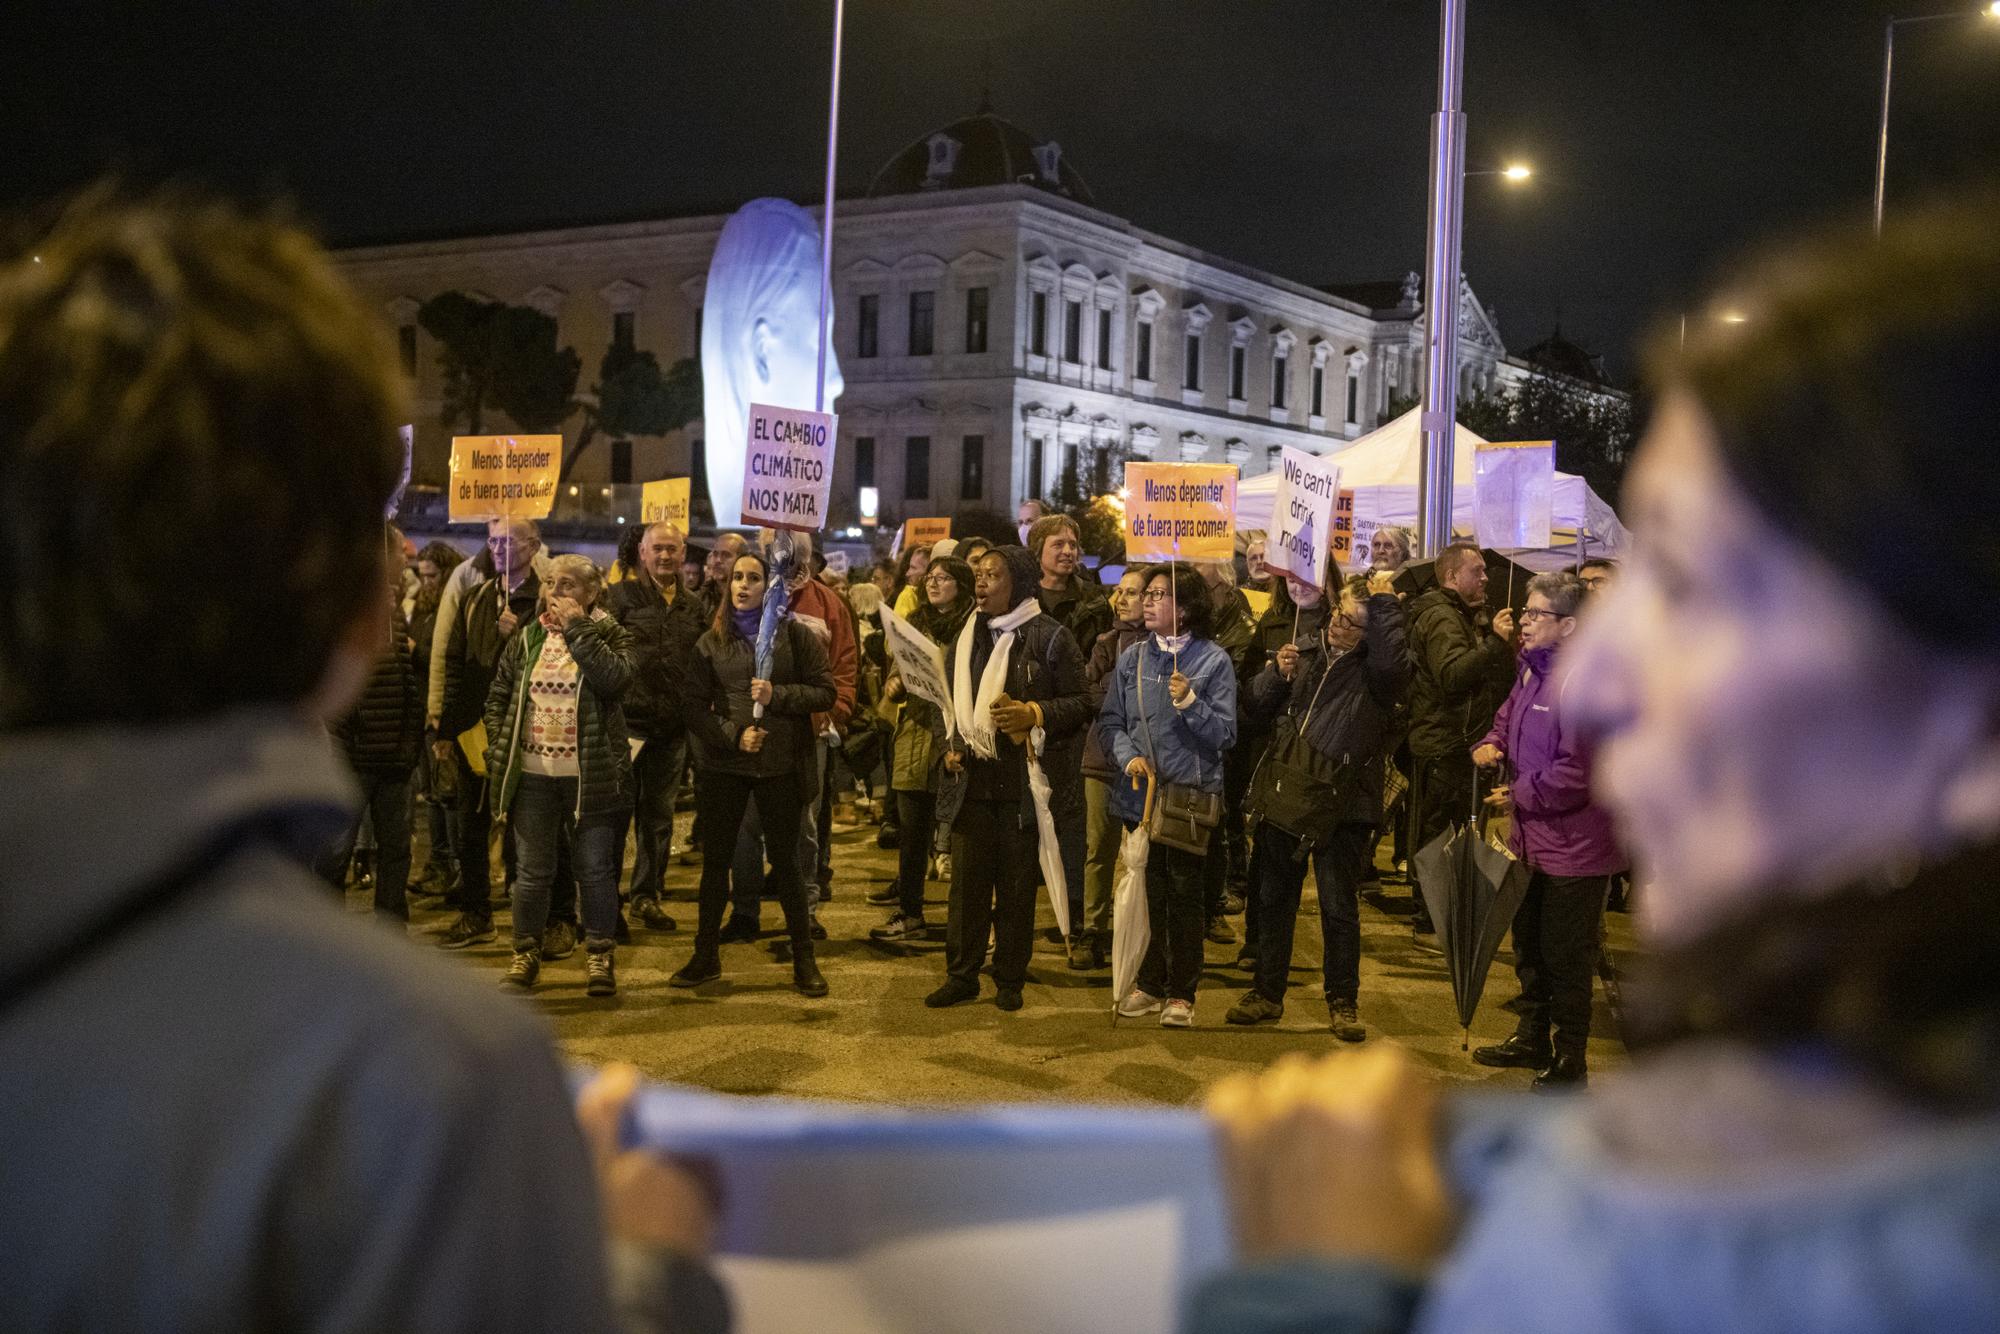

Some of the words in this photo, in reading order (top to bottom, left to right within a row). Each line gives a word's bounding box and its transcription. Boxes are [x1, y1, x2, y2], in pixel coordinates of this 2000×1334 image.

[754, 418, 770, 441] EL
[774, 420, 827, 447] CAMBIO
[472, 449, 503, 470] Menos
[506, 448, 550, 473] depender
[752, 450, 823, 482] CLIMÁTICO
[460, 481, 471, 500] de
[473, 480, 499, 499] fuera
[502, 484, 522, 504] para
[1284, 458, 1302, 485] We
[1304, 472, 1332, 499] can't
[749, 488, 779, 512] NOS
[782, 491, 818, 517] MATA.
[1145, 479, 1177, 502] Menos
[1180, 479, 1224, 508] depender
[1133, 514, 1145, 537] de
[1147, 514, 1172, 537] fuera
[1175, 519, 1195, 543] para
[1196, 519, 1229, 538] comer.
[1279, 529, 1316, 567] money.
